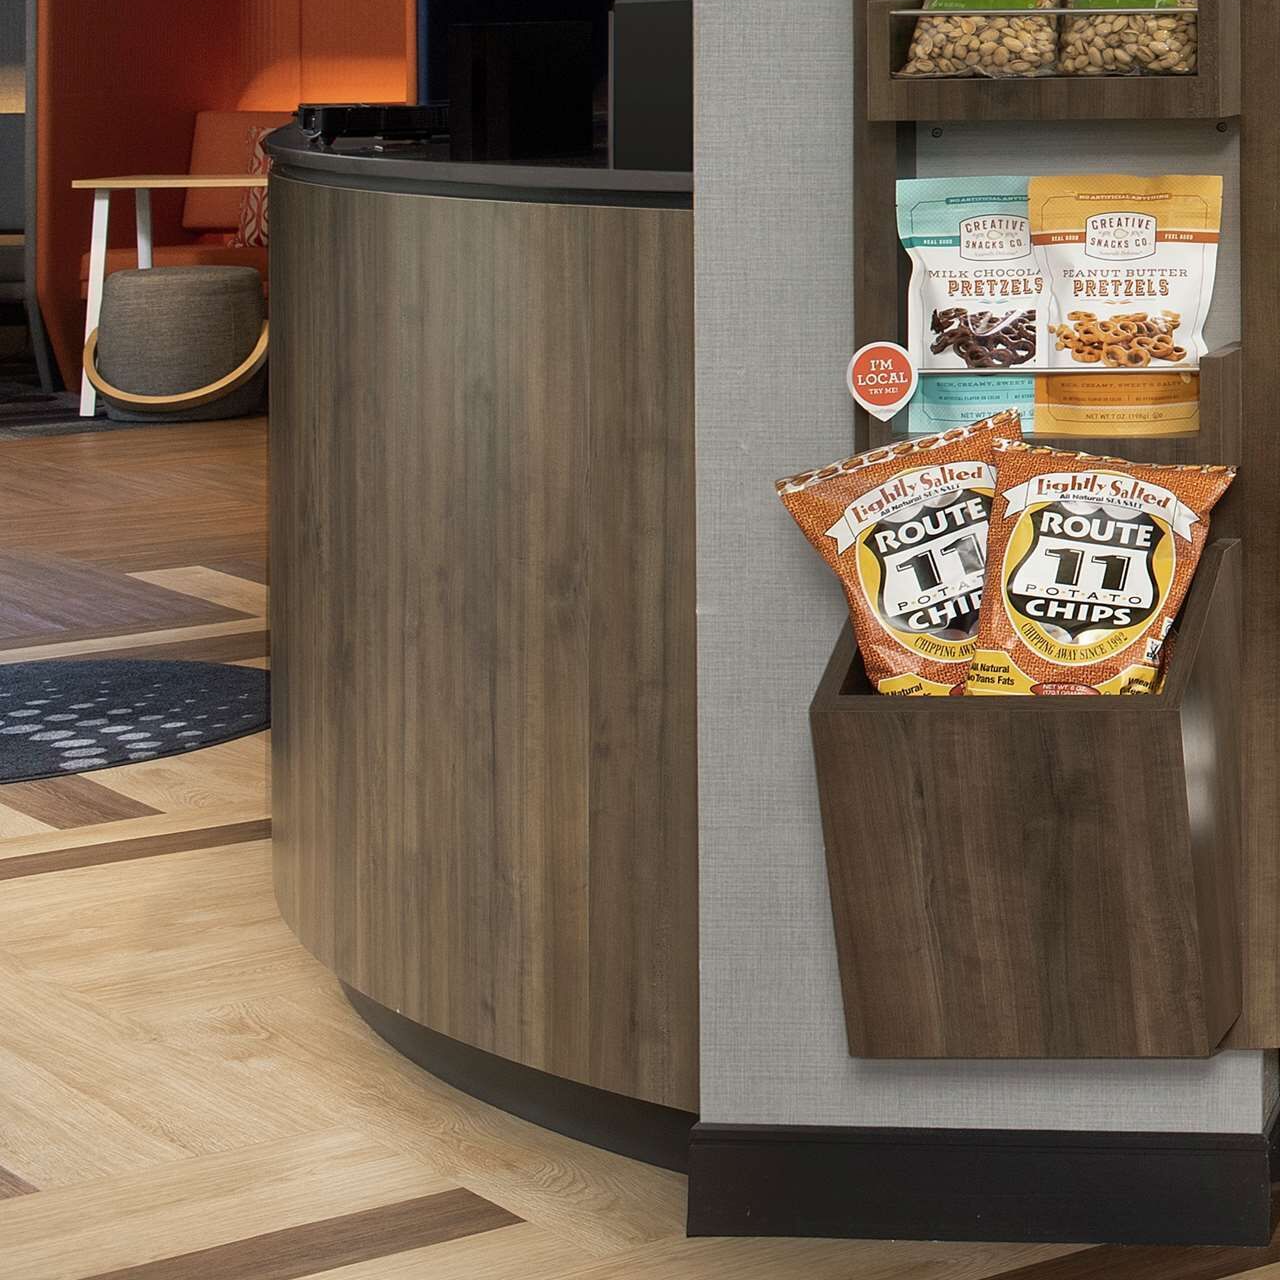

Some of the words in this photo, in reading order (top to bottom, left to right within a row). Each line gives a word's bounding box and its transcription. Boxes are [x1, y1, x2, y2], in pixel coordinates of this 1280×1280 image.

[964, 219, 1026, 233] CREATIVE
[1091, 218, 1152, 231] CREATIVE
[964, 240, 1004, 250] SNACKS
[1090, 237, 1129, 248] SNACKS
[928, 270, 969, 279] MILK
[1063, 269, 1121, 278] PEANUT
[1126, 268, 1188, 277] BUTTER
[948, 278, 1044, 297] PRETZELS
[1073, 279, 1169, 297] PRETZELS
[869, 359, 893, 371] I'M
[857, 371, 908, 386] LOCAL
[868, 387, 884, 395] TRY
[851, 478, 919, 523] Lightly
[920, 466, 984, 490] Salted
[1037, 475, 1107, 496] Lightly
[1110, 479, 1171, 509] Salted
[1072, 494, 1104, 502] Natural
[874, 497, 987, 554] ROUTE
[1040, 511, 1153, 547] ROUTE
[894, 532, 987, 592] 11
[1043, 547, 1132, 592] 11
[1025, 599, 1132, 625] CHIPS
[1020, 622, 1055, 657] CHIPPING
[1055, 648, 1078, 661] AWAY
[1079, 644, 1108, 660] SINCE
[1107, 631, 1129, 651] 1992
[980, 663, 1010, 673] Natural
[997, 675, 1015, 686] Fats
